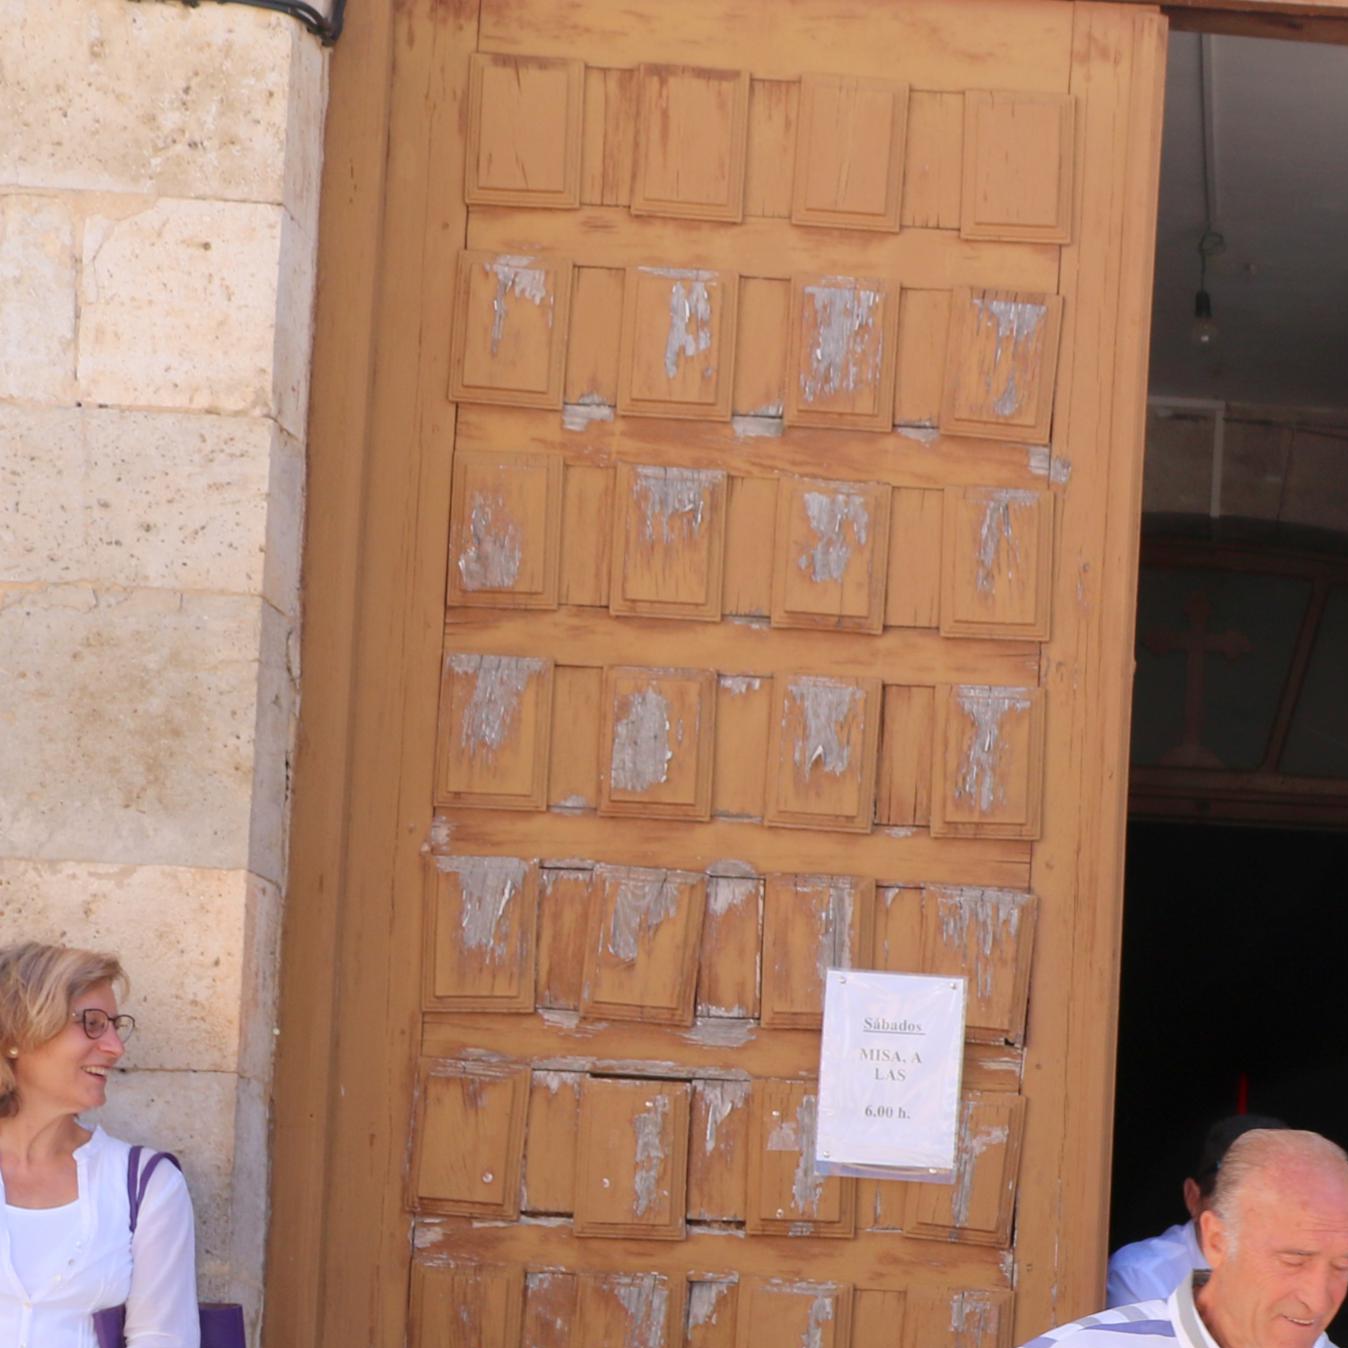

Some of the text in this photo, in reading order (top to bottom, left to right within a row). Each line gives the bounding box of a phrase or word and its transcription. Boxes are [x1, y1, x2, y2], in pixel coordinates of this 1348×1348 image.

[863, 1017, 922, 1032] Sábados
[911, 1051, 922, 1064] A
[874, 1068, 906, 1081] LAS
[865, 1105, 910, 1119] 6.00 h.
